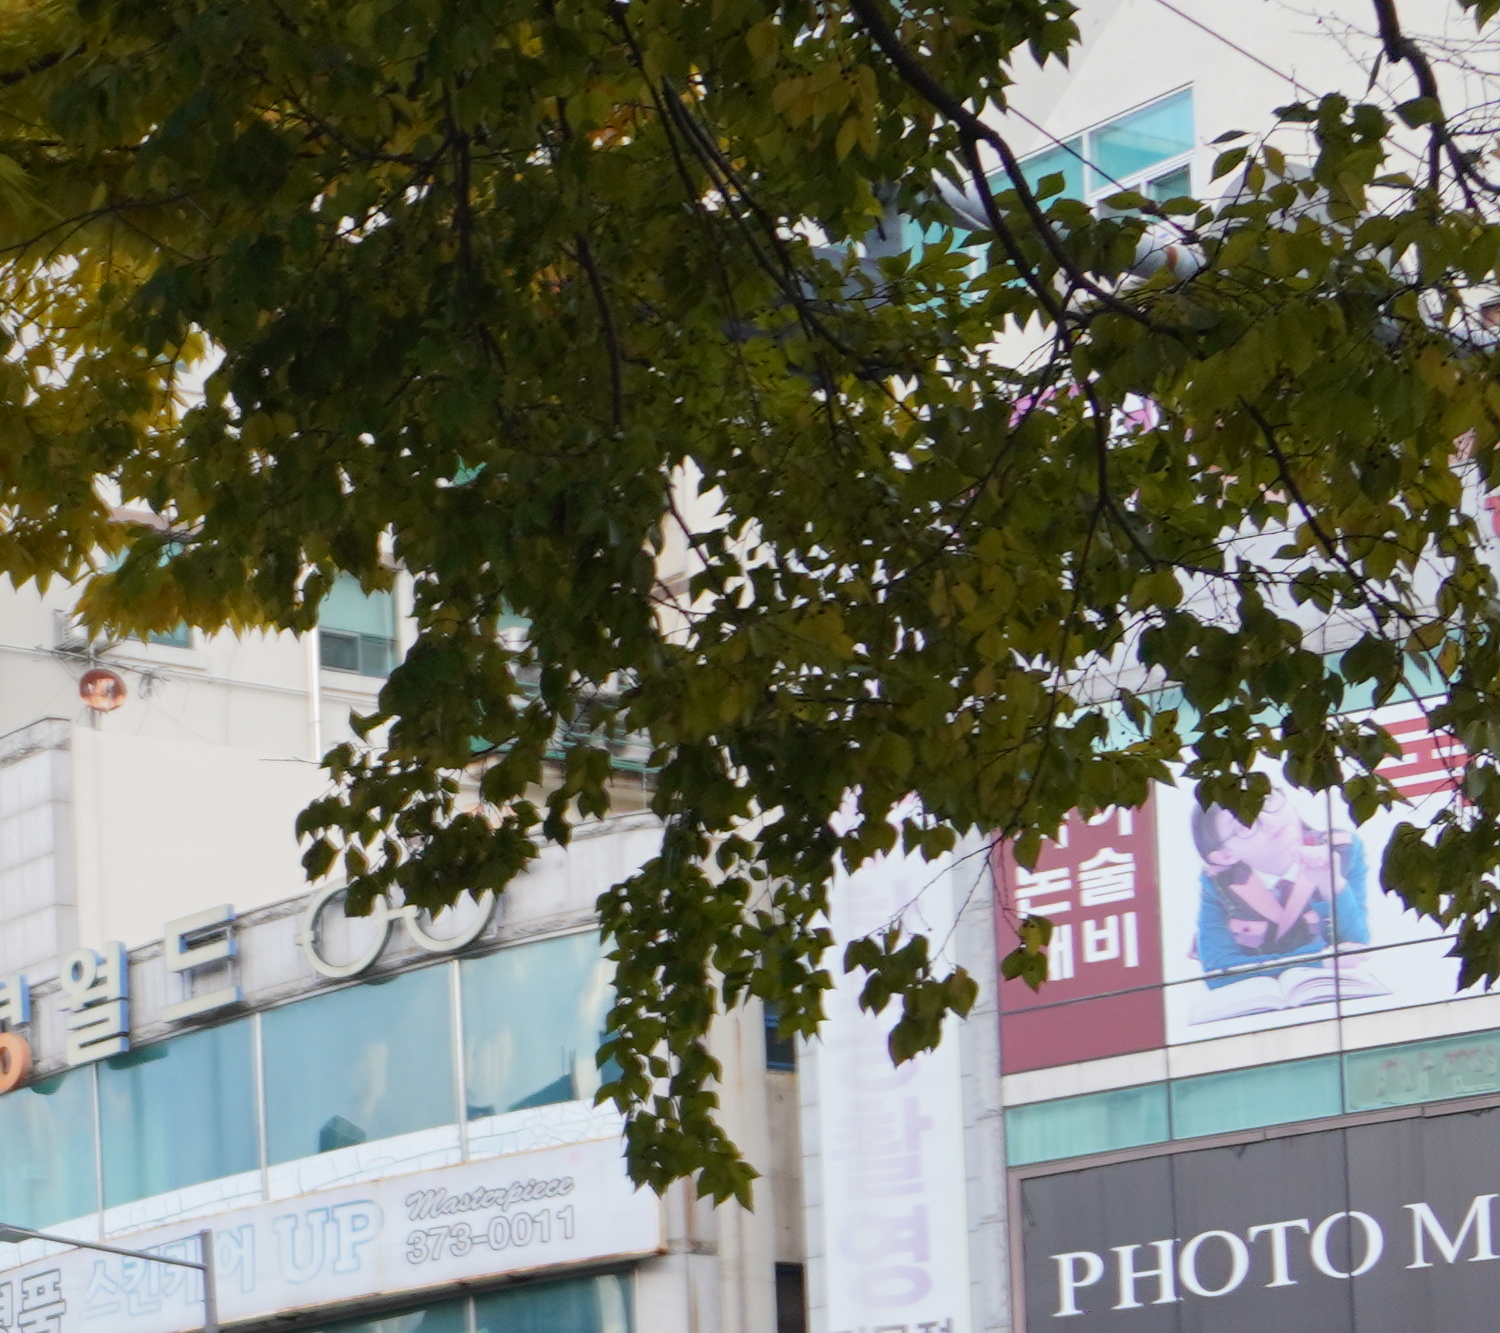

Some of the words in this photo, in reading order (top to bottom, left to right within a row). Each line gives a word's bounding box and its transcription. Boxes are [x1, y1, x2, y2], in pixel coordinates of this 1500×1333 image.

[405, 1175, 576, 1222] Masterpiece
[405, 1204, 577, 1266] 373-0011
[272, 1199, 385, 1286] UP
[1051, 1210, 1386, 1319] PHOTO
